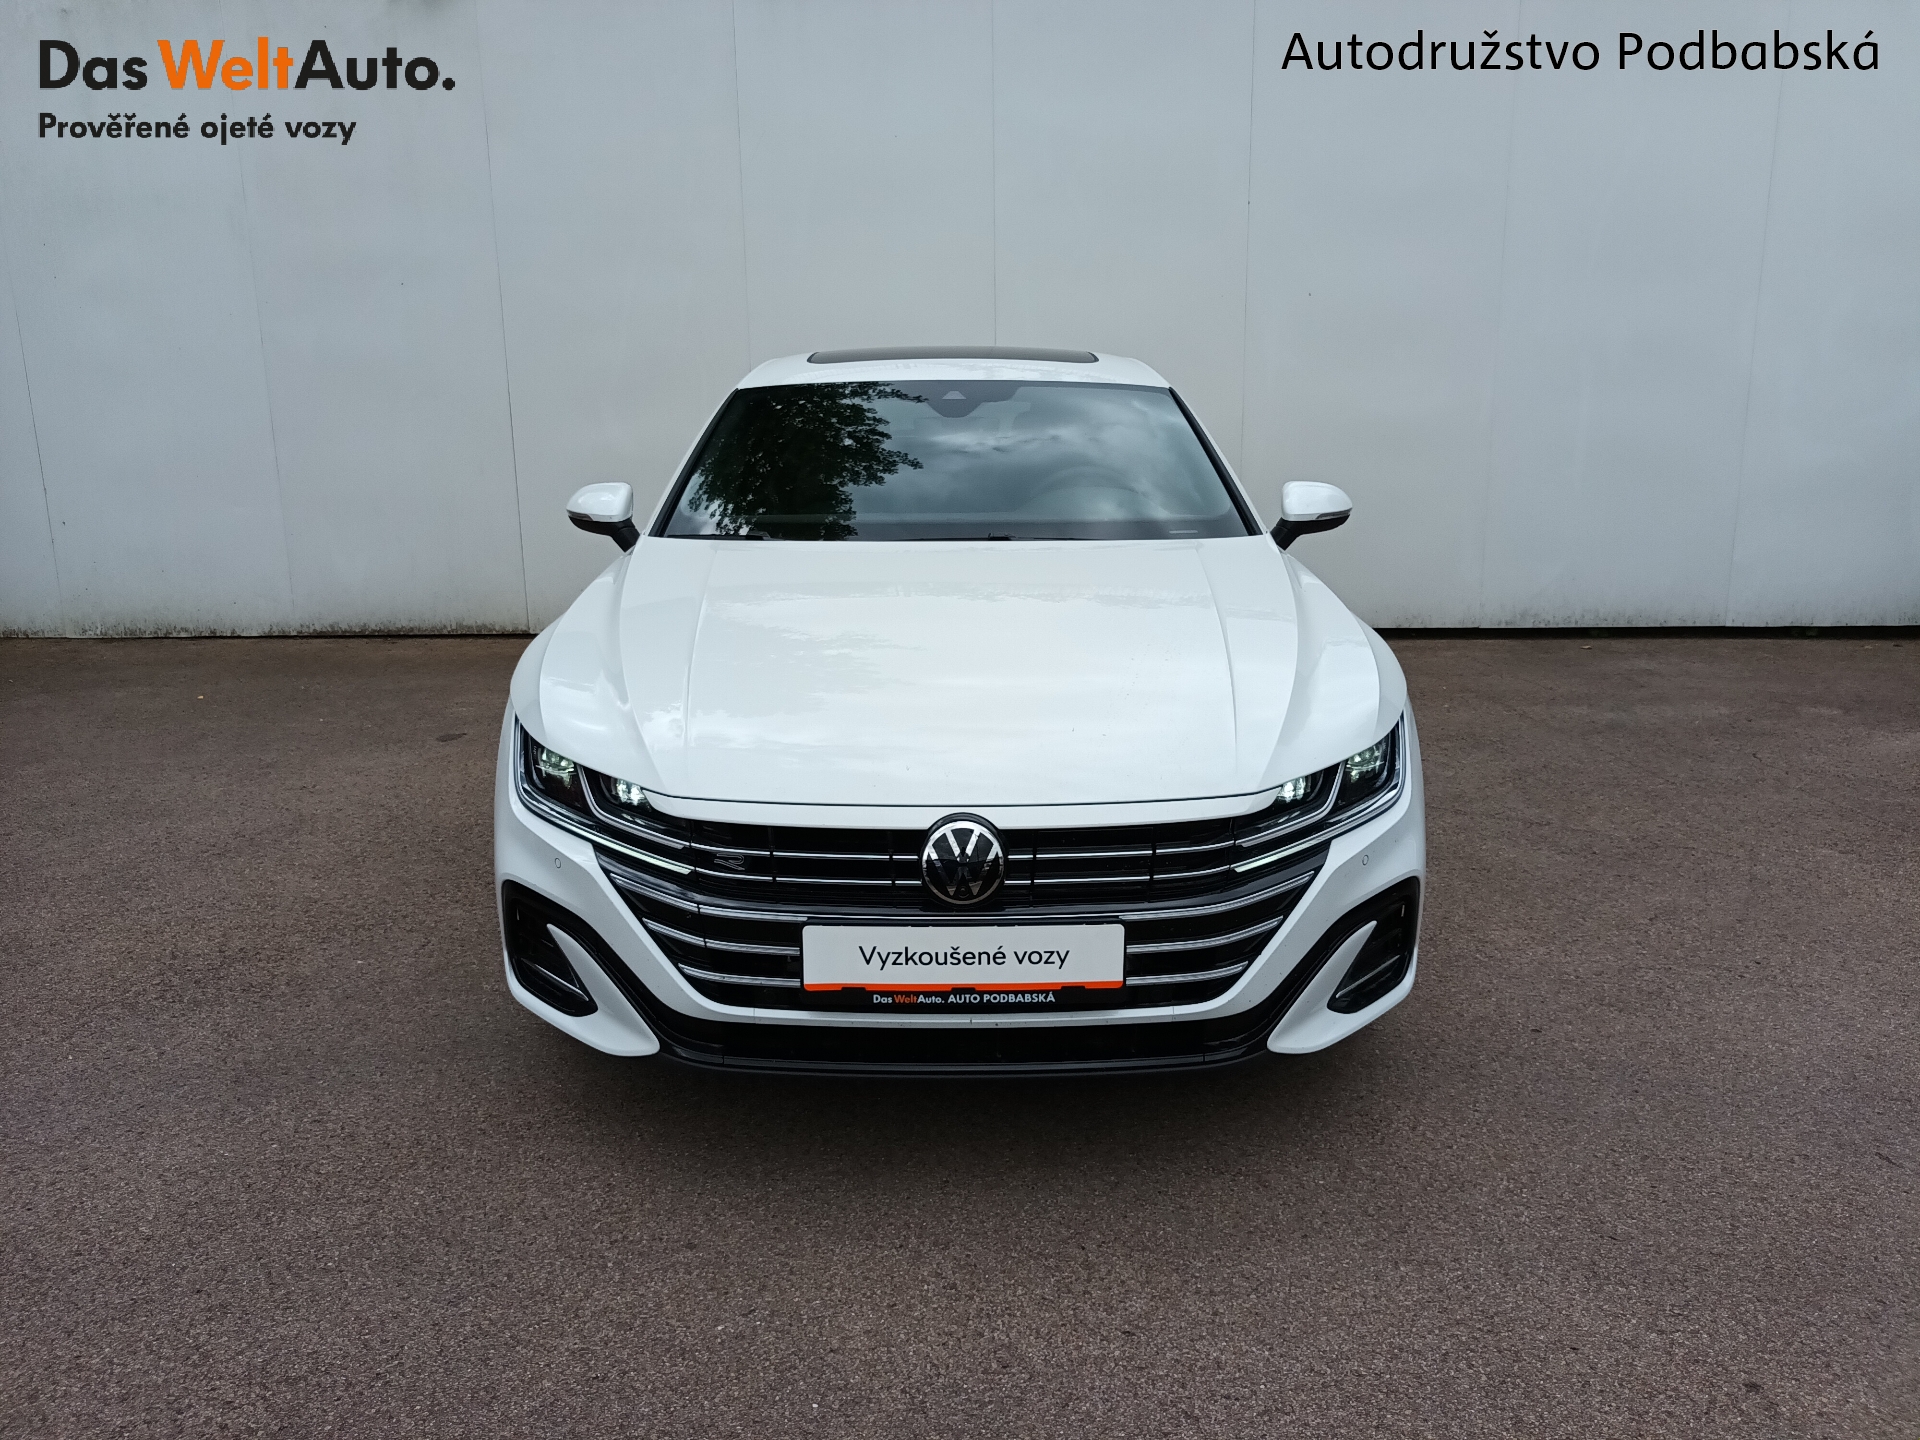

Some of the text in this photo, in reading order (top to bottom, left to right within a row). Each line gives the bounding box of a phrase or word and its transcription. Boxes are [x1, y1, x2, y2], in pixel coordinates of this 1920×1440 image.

[858, 945, 1070, 971] Vyzkoušené vozy
[873, 994, 893, 1004] Das
[947, 993, 981, 1004] AUTO
[983, 991, 1056, 1004] PODBABSKÁ
